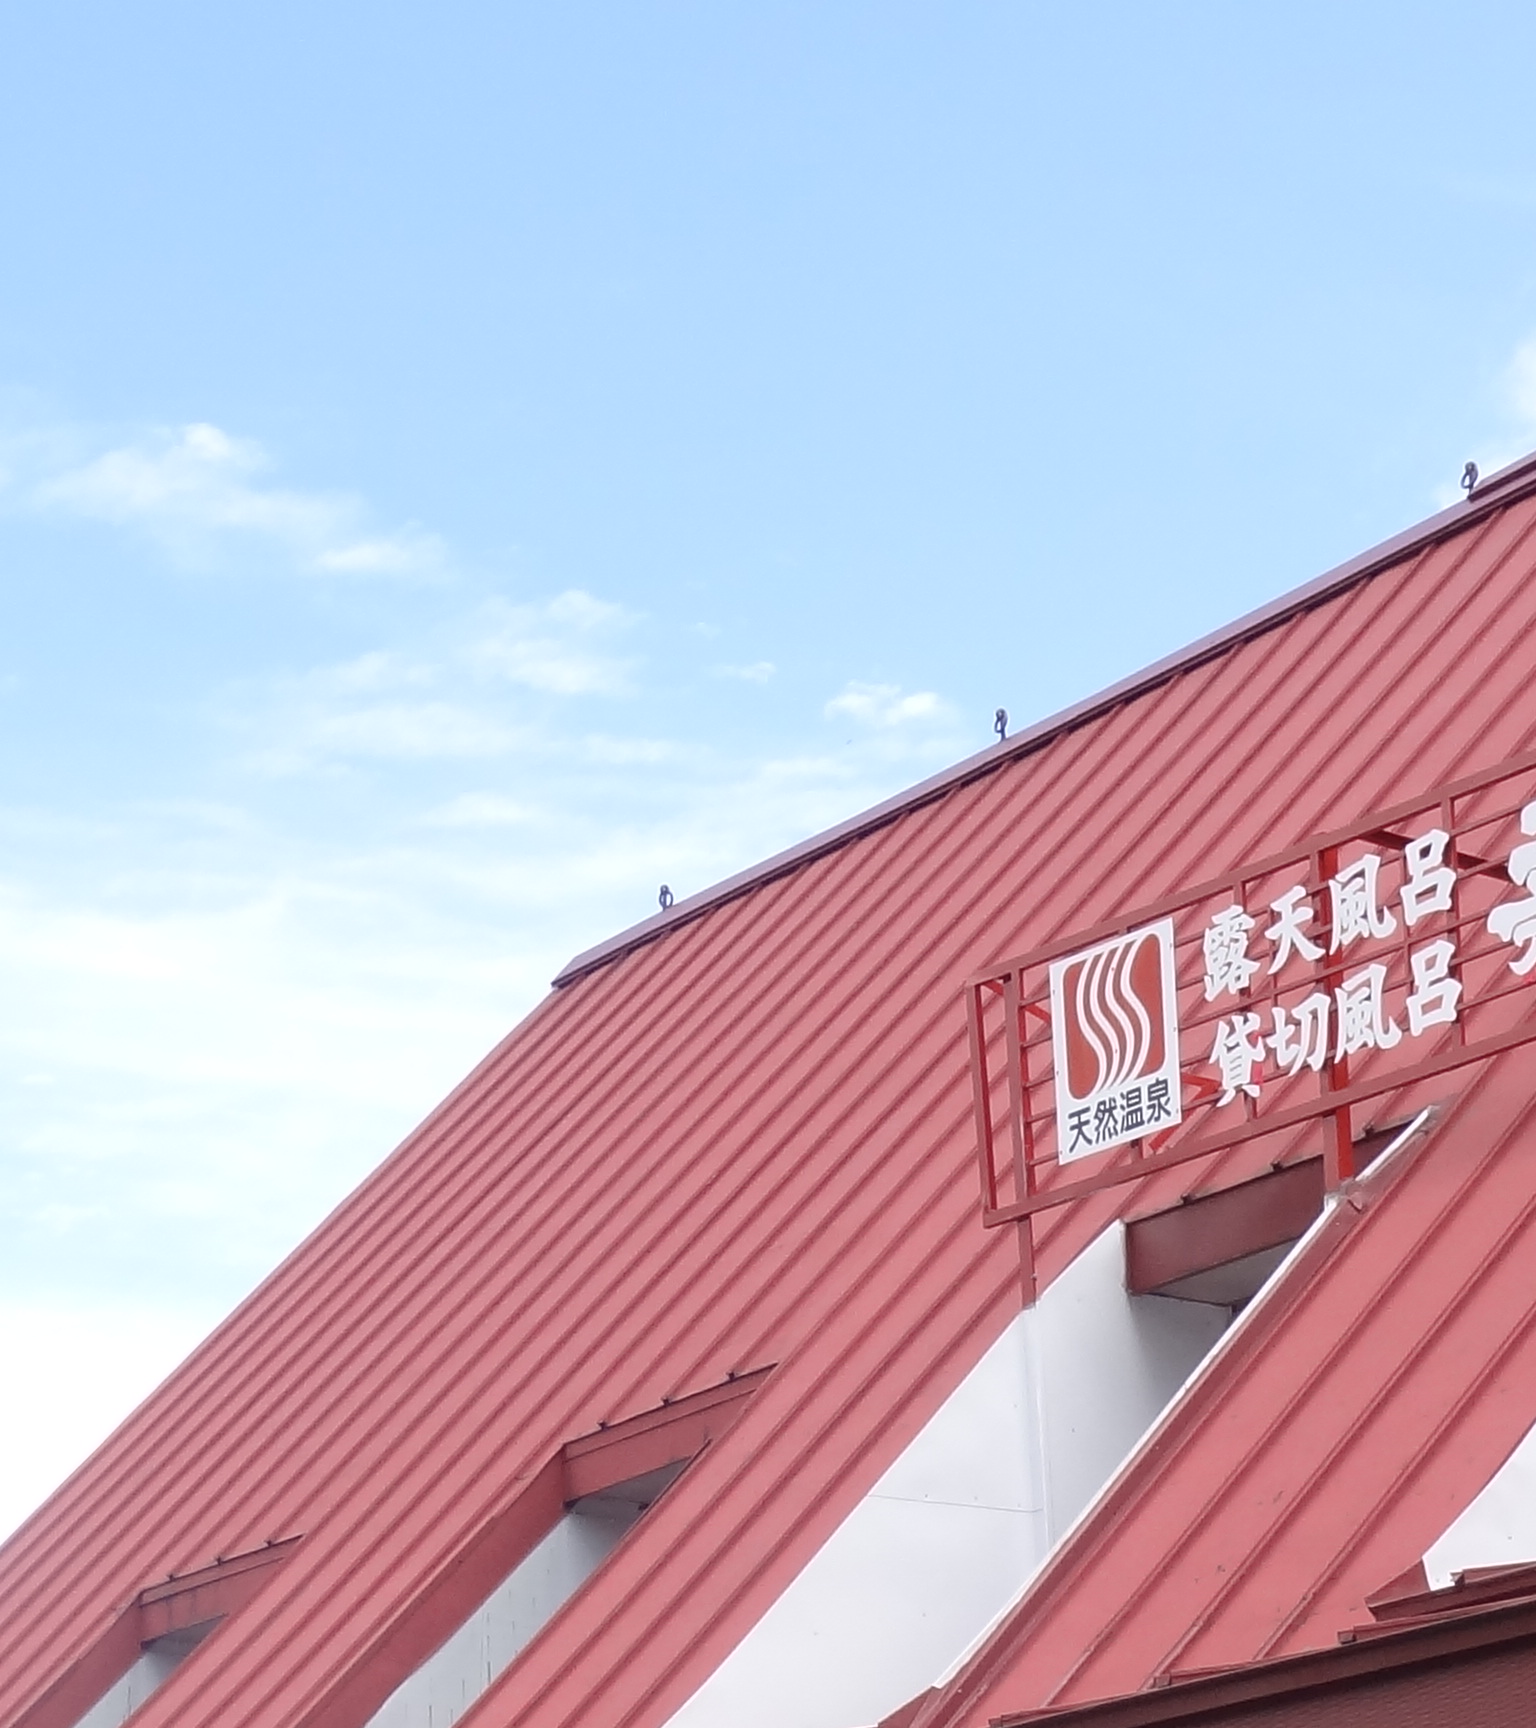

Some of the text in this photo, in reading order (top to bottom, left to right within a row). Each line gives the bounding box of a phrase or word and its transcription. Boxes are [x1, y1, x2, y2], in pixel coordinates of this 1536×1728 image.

[1202, 829, 1457, 1003] 露天風呂
[1209, 939, 1462, 1107] 貸切風呂
[1067, 1077, 1171, 1154] 天然温泉
